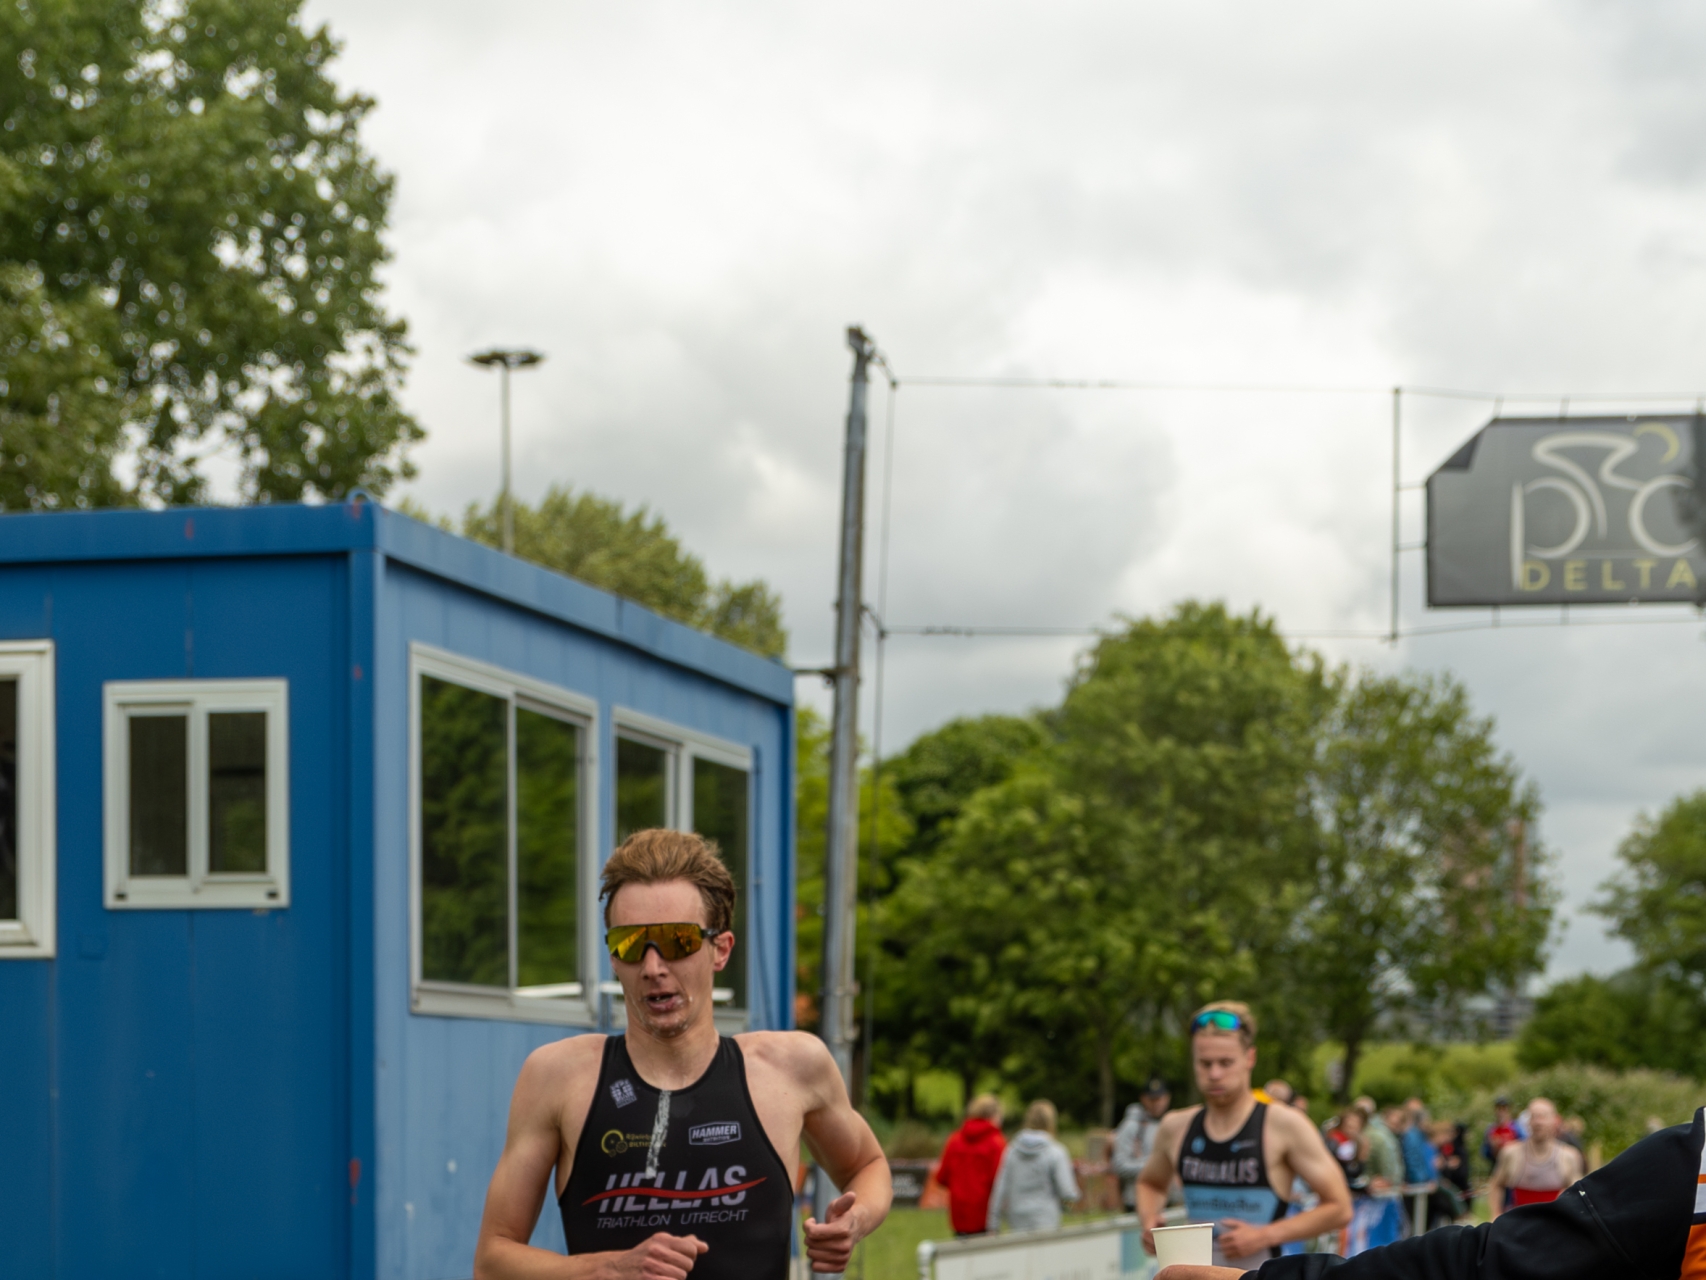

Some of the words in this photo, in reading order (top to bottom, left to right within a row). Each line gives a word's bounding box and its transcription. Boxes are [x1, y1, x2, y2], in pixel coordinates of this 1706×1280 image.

[1521, 560, 1697, 591] DELTA
[692, 1125, 737, 1139] HAMMER
[599, 1165, 747, 1213] HELLAS
[596, 1214, 672, 1229] TRIATHLON
[680, 1209, 748, 1225] UTRECHT
